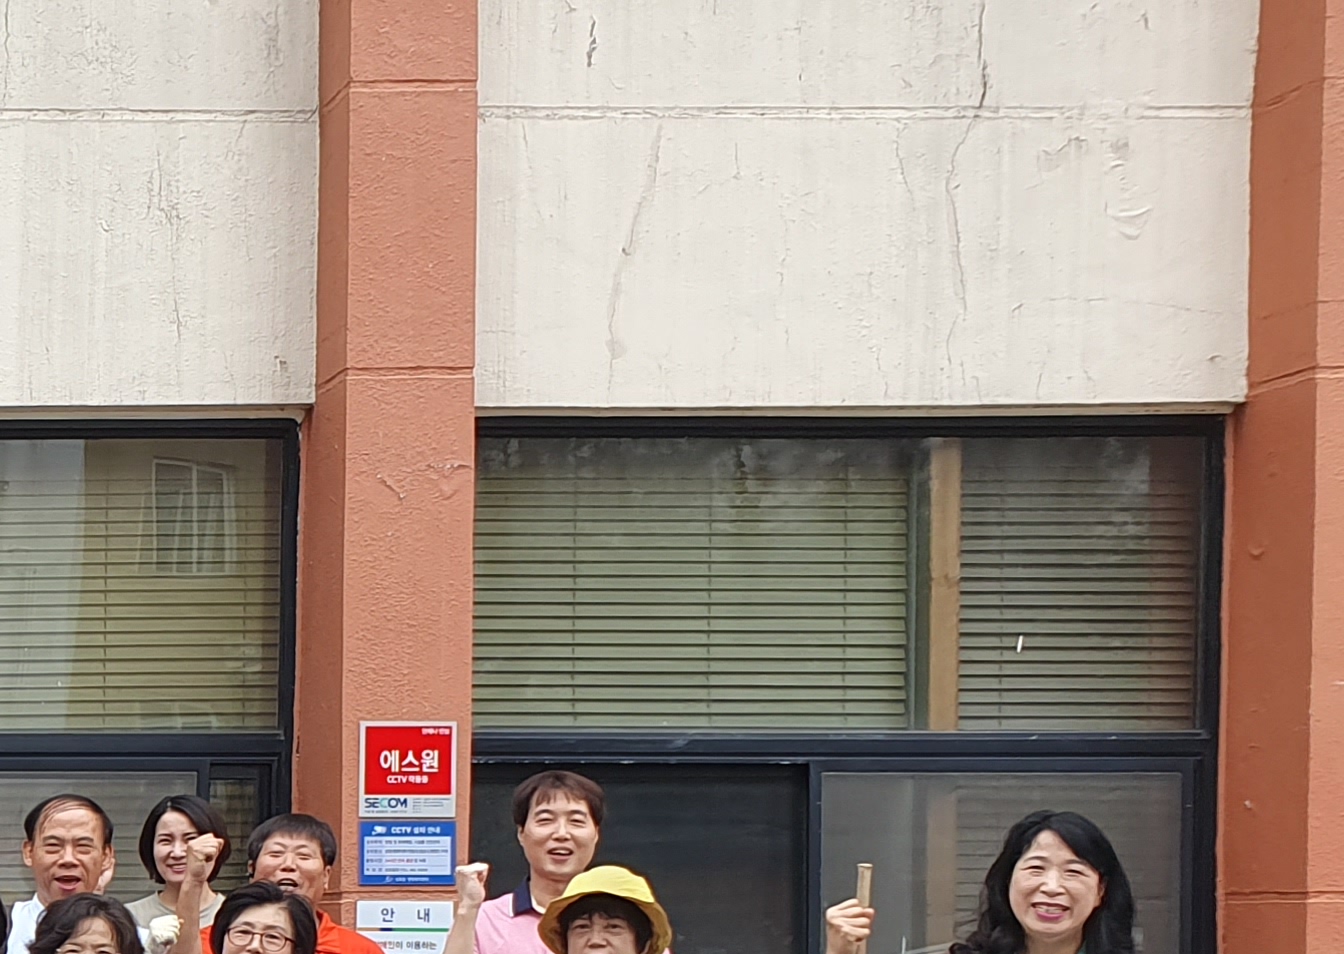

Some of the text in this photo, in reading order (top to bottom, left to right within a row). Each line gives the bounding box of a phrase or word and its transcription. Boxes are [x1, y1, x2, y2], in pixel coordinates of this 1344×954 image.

[379, 749, 439, 773] 에스원
[386, 775, 408, 784] CCTV
[364, 797, 408, 809] SECOM
[391, 826, 412, 834] CCTV
[406, 941, 437, 950] 이용하는
